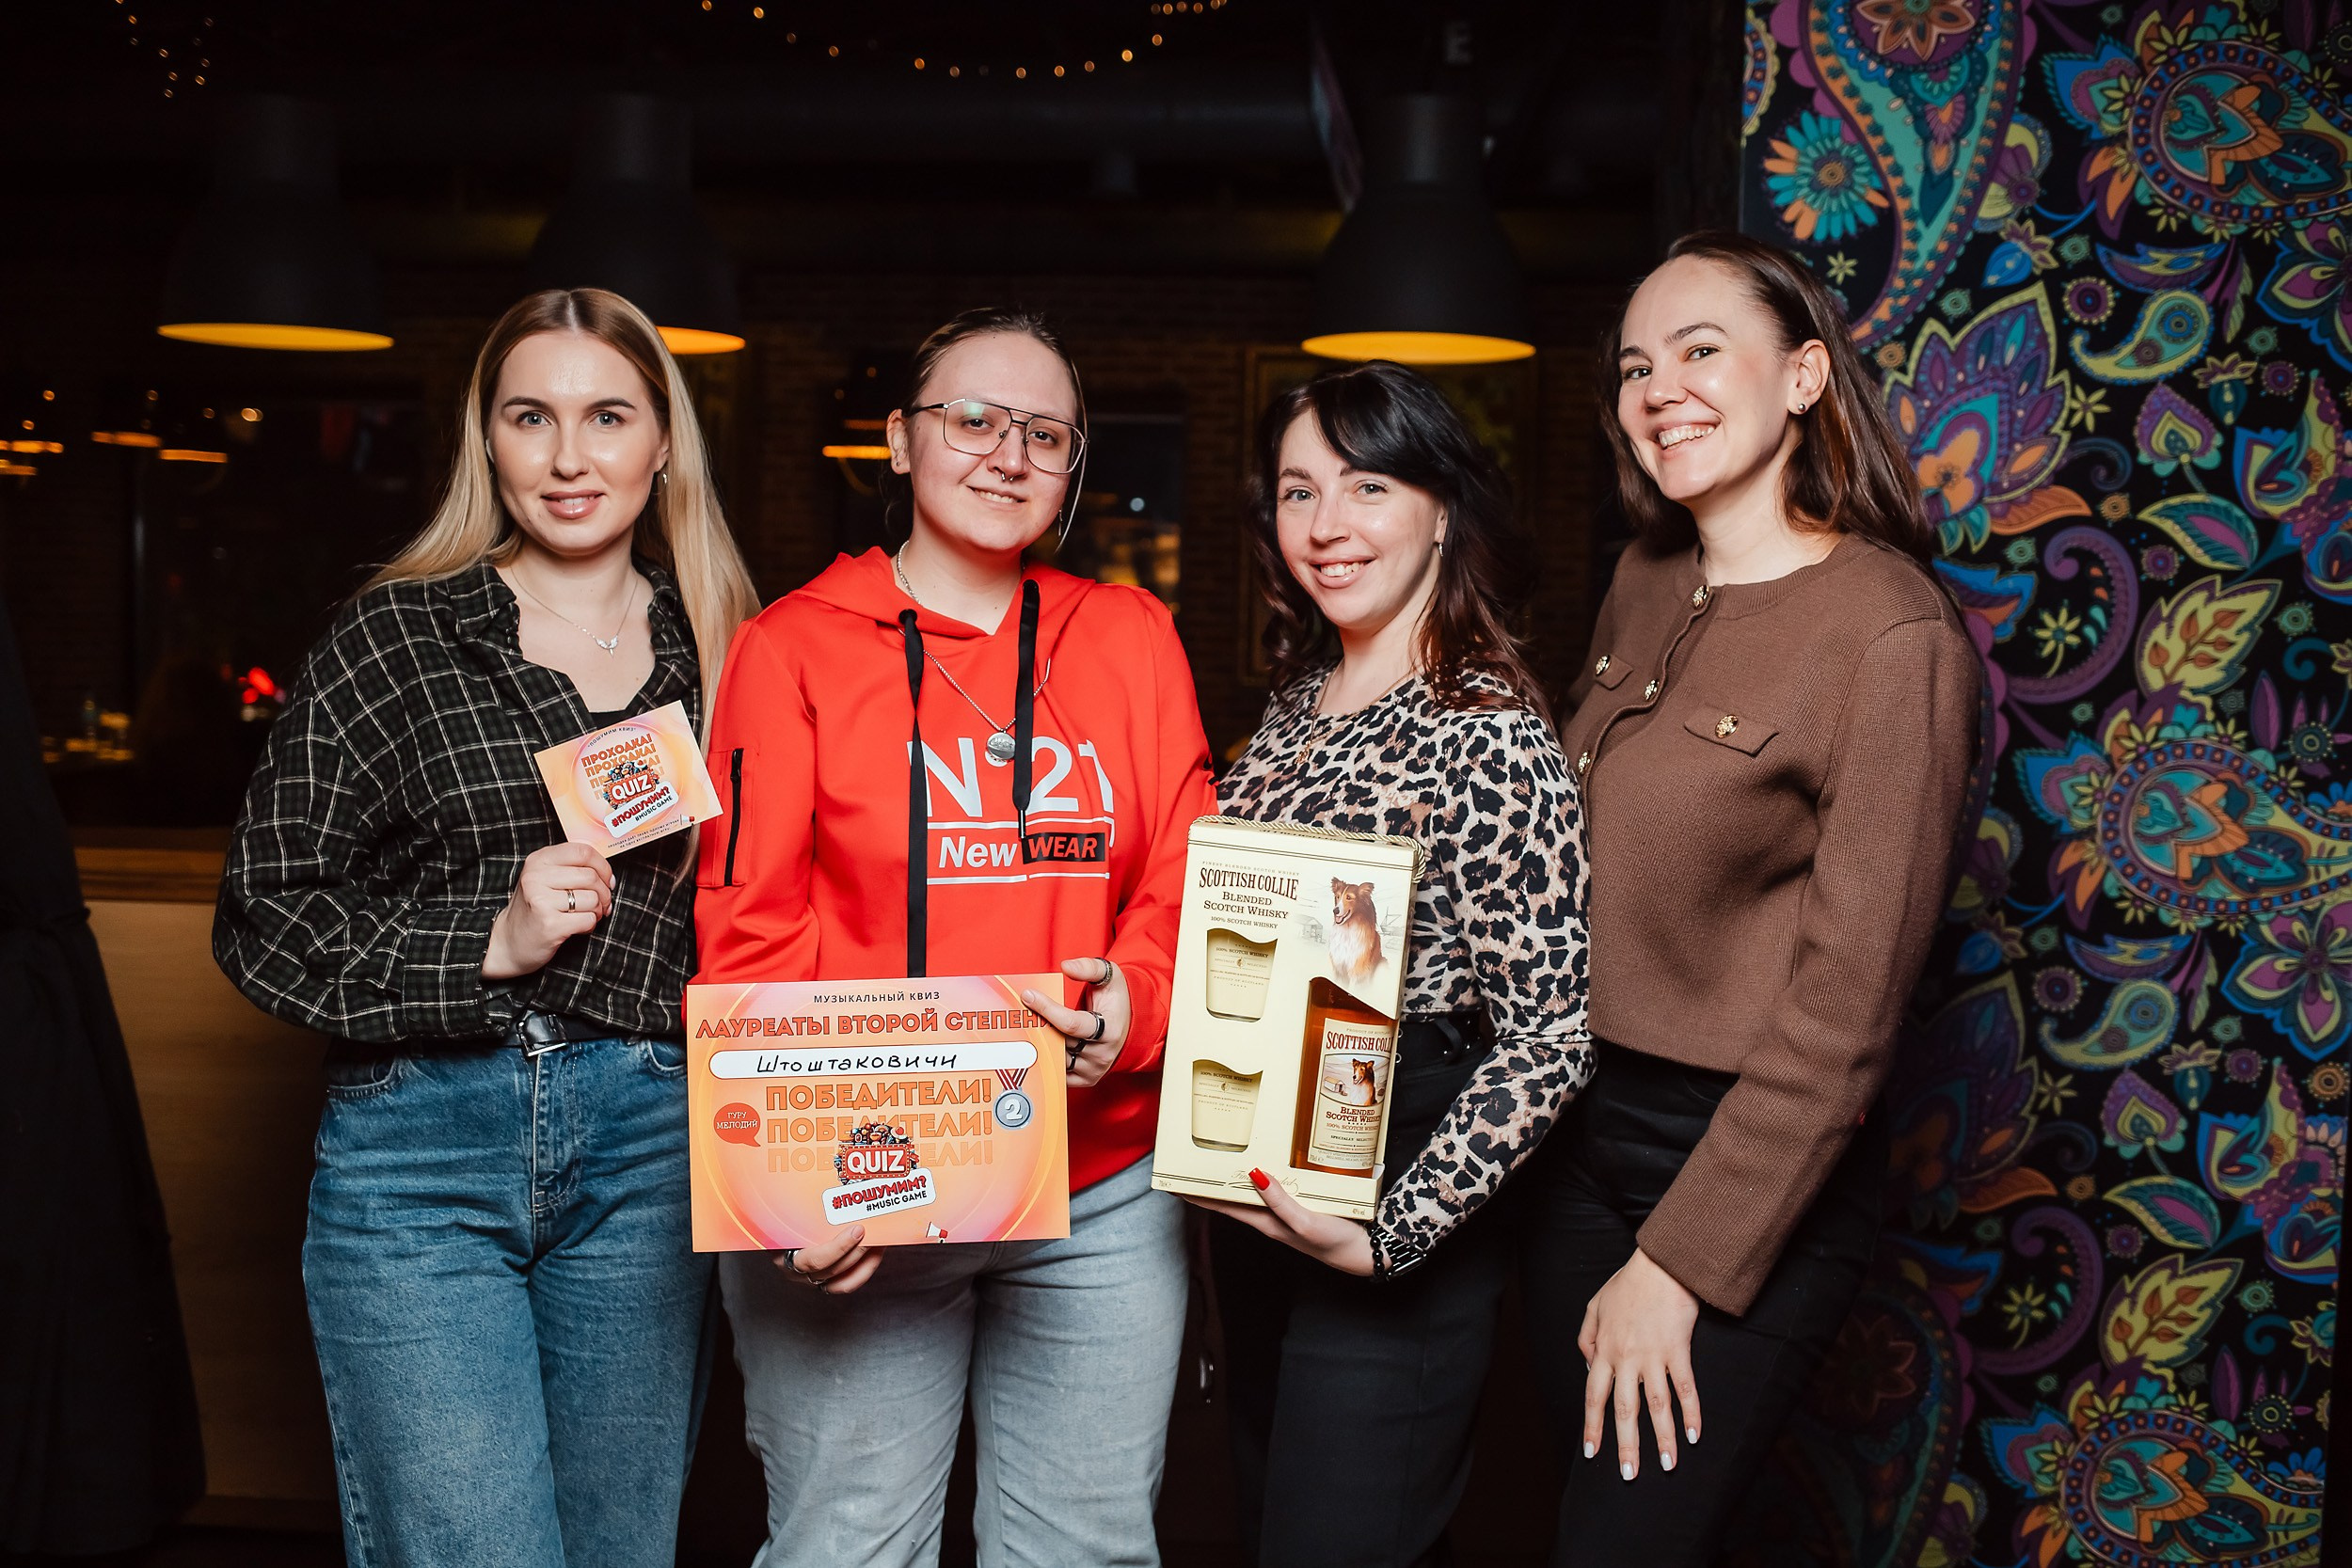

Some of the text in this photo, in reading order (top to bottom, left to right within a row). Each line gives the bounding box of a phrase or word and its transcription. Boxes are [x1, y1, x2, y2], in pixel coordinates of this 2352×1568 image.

[581, 733, 653, 768] ПРОХОДКА!
[612, 774, 652, 800] QUIZ
[612, 786, 670, 827] #ПОШУМИМ?
[635, 795, 673, 822] #MUSIC GAME
[938, 835, 1098, 868] New WEAR
[1199, 867, 1299, 901] SCOTTISH COLLIE
[1203, 900, 1289, 919] SCOTCH WHISKY
[1222, 891, 1272, 906] BLENDED
[1253, 921, 1279, 929] WHISKY
[814, 991, 940, 1004] МУЗЫКАЛЬНЫЙ КВИЗ
[695, 1007, 1053, 1038] ЛАУРЕАТЫ ВТОРОЙ СТЕПЕН
[1326, 1030, 1375, 1051] SCOTTISH
[766, 1079, 992, 1110] ПОБЕДИТЕЛИ!
[1004, 1099, 1023, 1120] 2
[1326, 1111, 1359, 1122] SCOTCH
[1340, 1106, 1375, 1116] BLENDED
[716, 1119, 758, 1130] МЕЛОДИЙ
[847, 1149, 905, 1174] QUIZ
[832, 1175, 927, 1210] #ПОШУМИМ?
[866, 1190, 928, 1212] #MUSIC GAME
